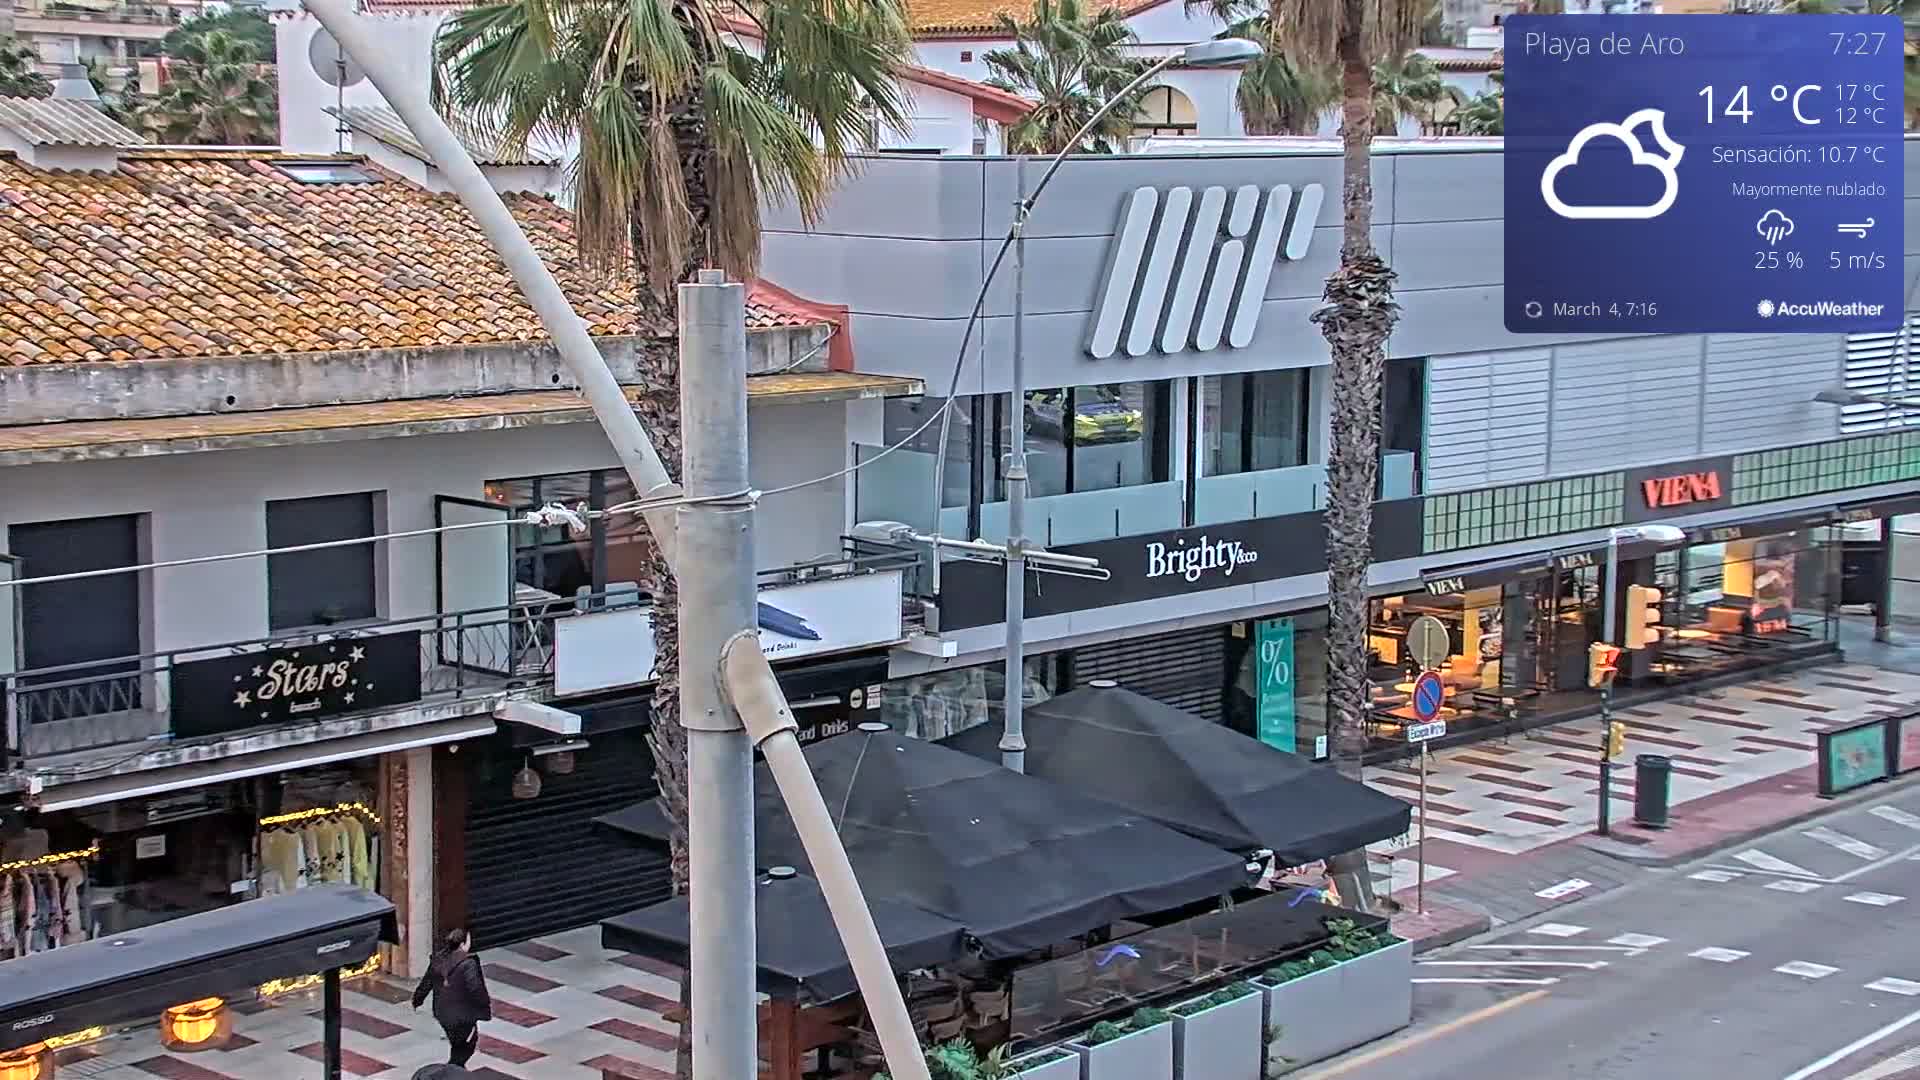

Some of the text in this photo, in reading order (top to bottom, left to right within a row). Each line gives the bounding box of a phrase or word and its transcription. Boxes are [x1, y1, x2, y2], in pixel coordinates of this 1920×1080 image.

[1641, 472, 1723, 509] VIENA
[257, 659, 350, 700] Stars
[12, 1014, 54, 1031] ROSSO
